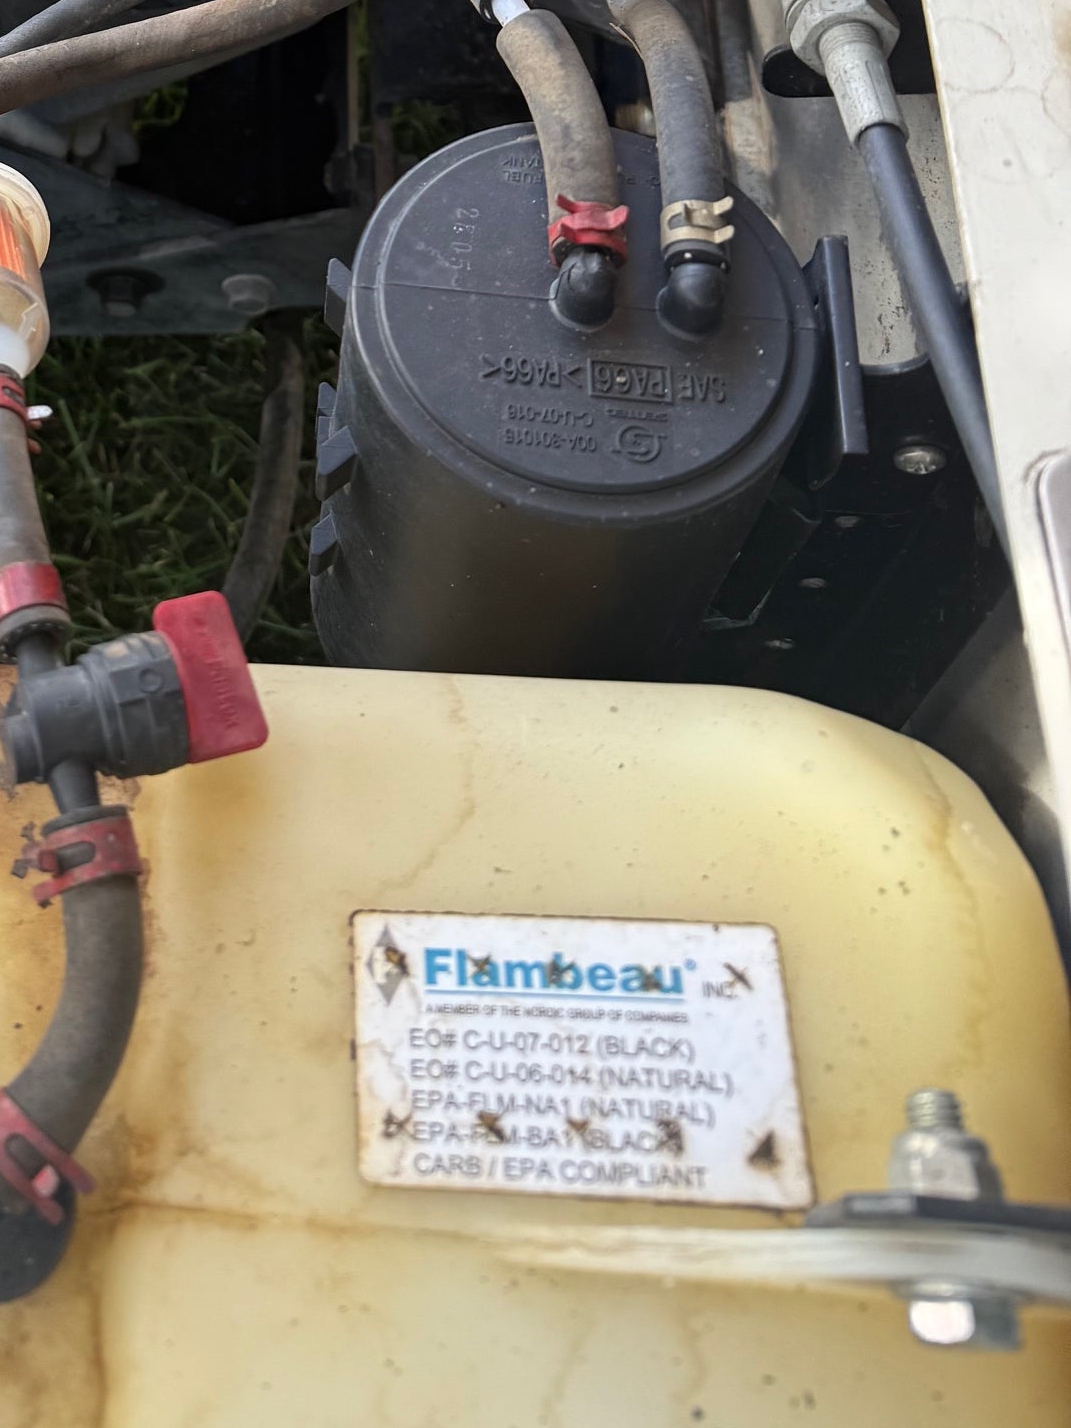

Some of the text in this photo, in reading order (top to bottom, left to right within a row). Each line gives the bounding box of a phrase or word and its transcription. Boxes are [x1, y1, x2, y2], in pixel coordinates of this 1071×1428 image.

[501, 153, 543, 169] TANK
[502, 170, 543, 185] FUEL
[596, 365, 667, 398] PA66
[678, 373, 727, 404] SAE
[434, 1004, 480, 1016] MEMBER
[484, 1005, 498, 1016] OF
[501, 1006, 521, 1017] THE
[523, 1007, 565, 1018] NORDIC
[567, 1008, 605, 1020] GROUP
[625, 1010, 689, 1023] COMPANIES
[409, 1027, 696, 1064] EO# C-U-07-012 (BLACK)
[410, 1058, 735, 1098] EO# C-U-06-014 (NATURAL)
[581, 1097, 717, 1129] (NATURAL)
[412, 1152, 483, 1177] CARB
[503, 1157, 554, 1181] EPA
[560, 1159, 709, 1188] COMPLIANT
